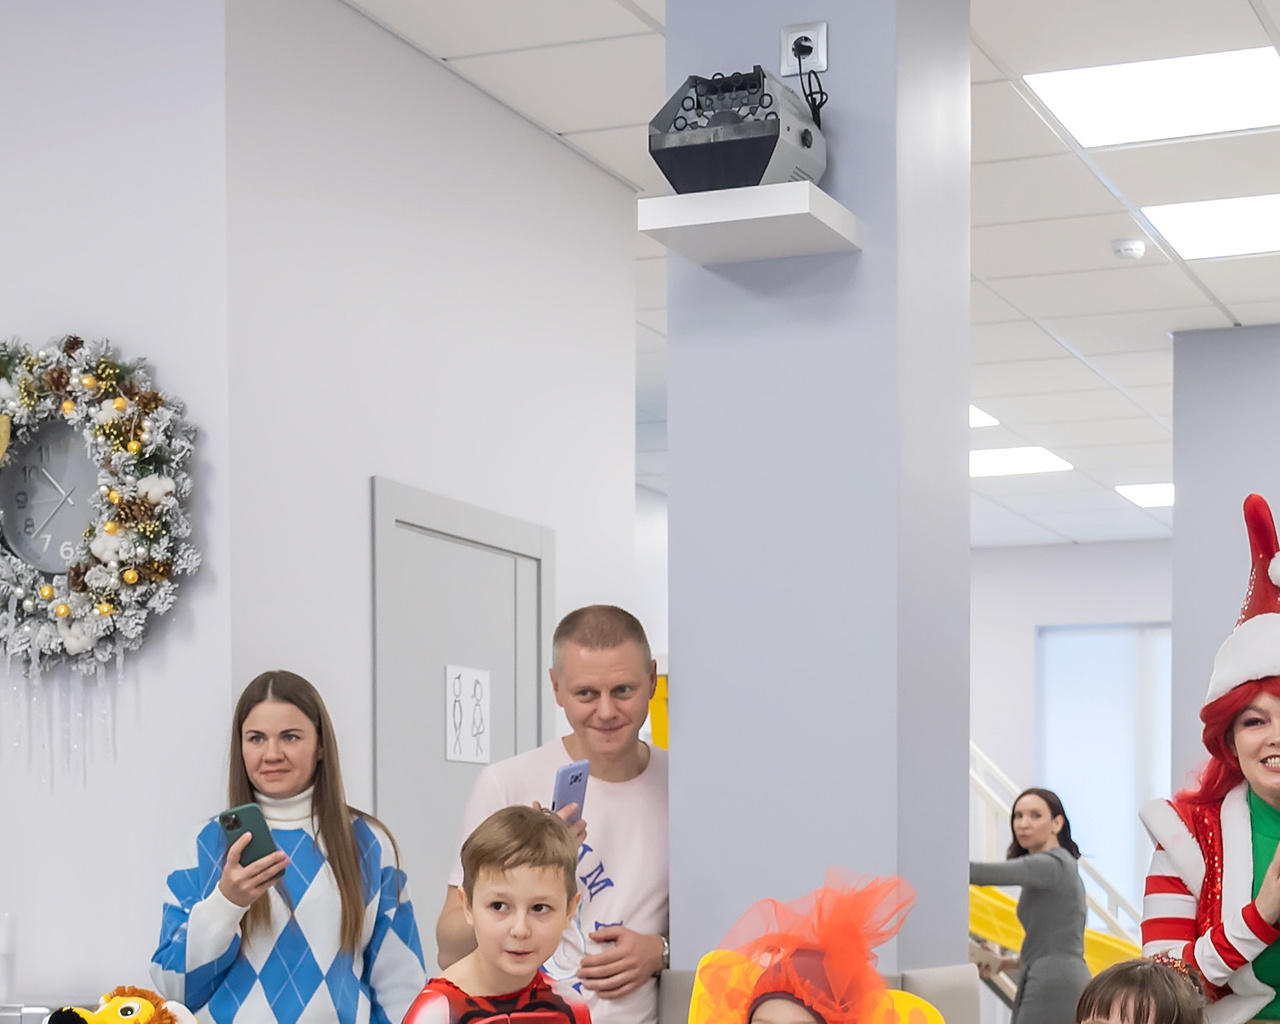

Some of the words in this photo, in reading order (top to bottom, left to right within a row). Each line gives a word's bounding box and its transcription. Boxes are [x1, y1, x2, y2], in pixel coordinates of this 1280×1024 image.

[37, 445, 51, 463] 11
[21, 465, 39, 484] 10
[15, 491, 28, 510] 9
[24, 517, 35, 535] 8
[40, 535, 52, 552] 7
[59, 541, 74, 560] 6
